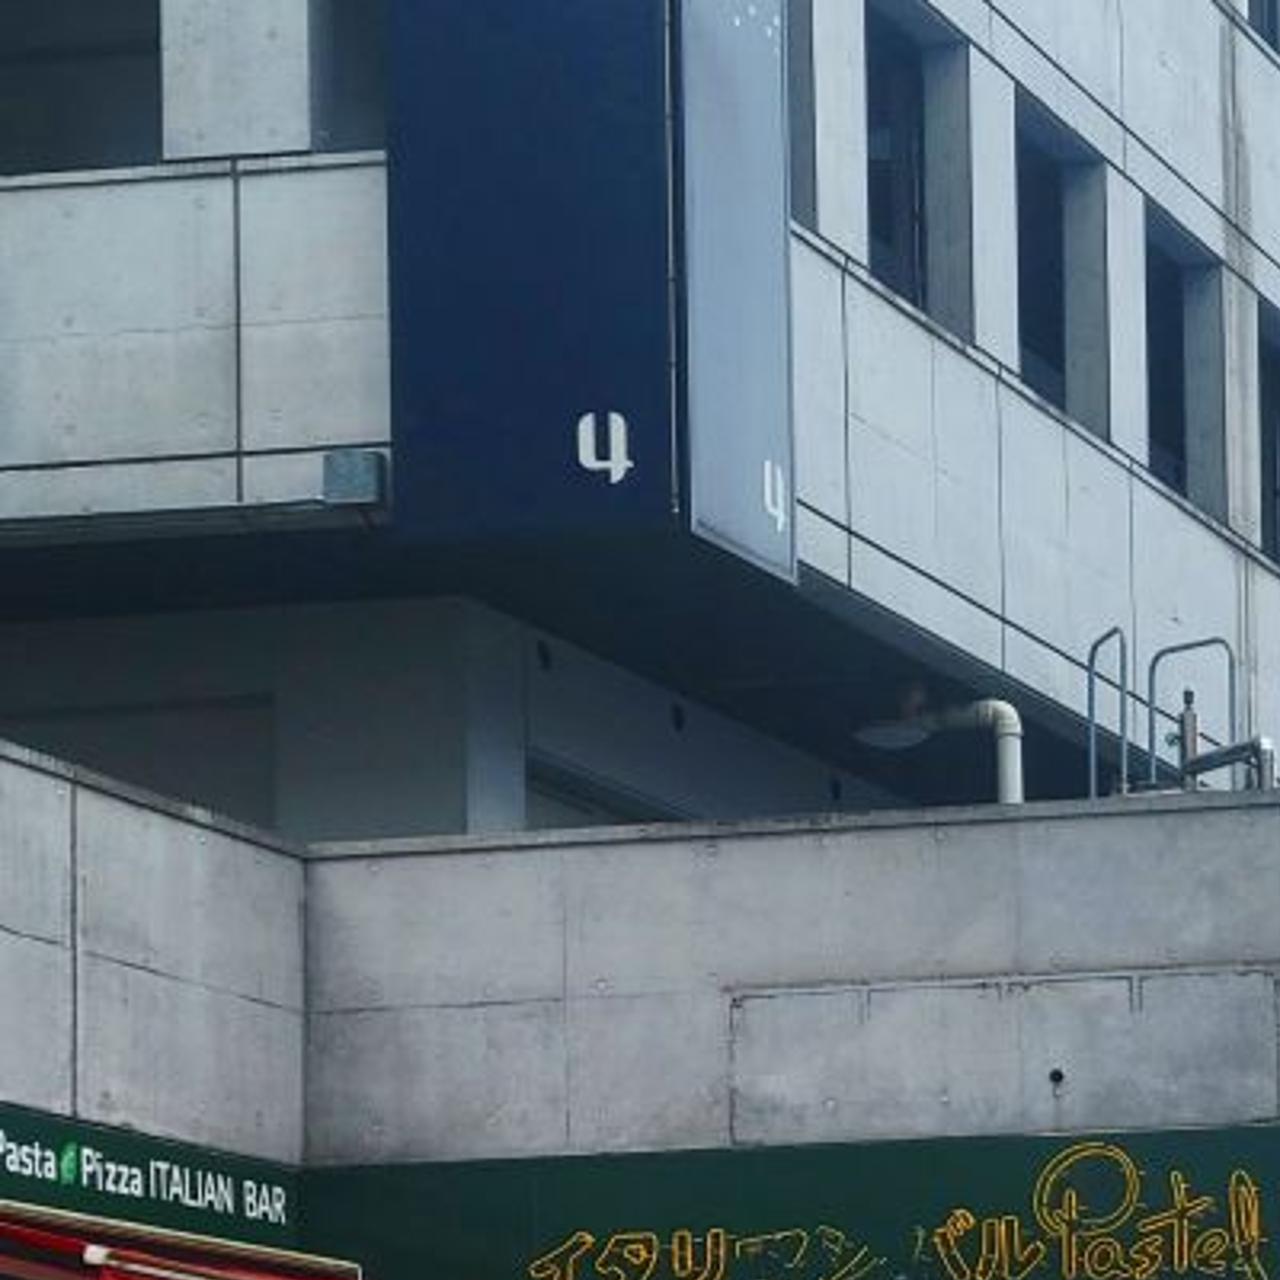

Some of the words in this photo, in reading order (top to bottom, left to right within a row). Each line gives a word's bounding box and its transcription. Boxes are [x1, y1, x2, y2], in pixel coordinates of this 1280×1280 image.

[578, 411, 635, 484] 4
[763, 459, 785, 532] 4
[81, 1146, 145, 1198] Pizza
[149, 1160, 234, 1216] ITALIAN
[244, 1180, 287, 1225] BAR
